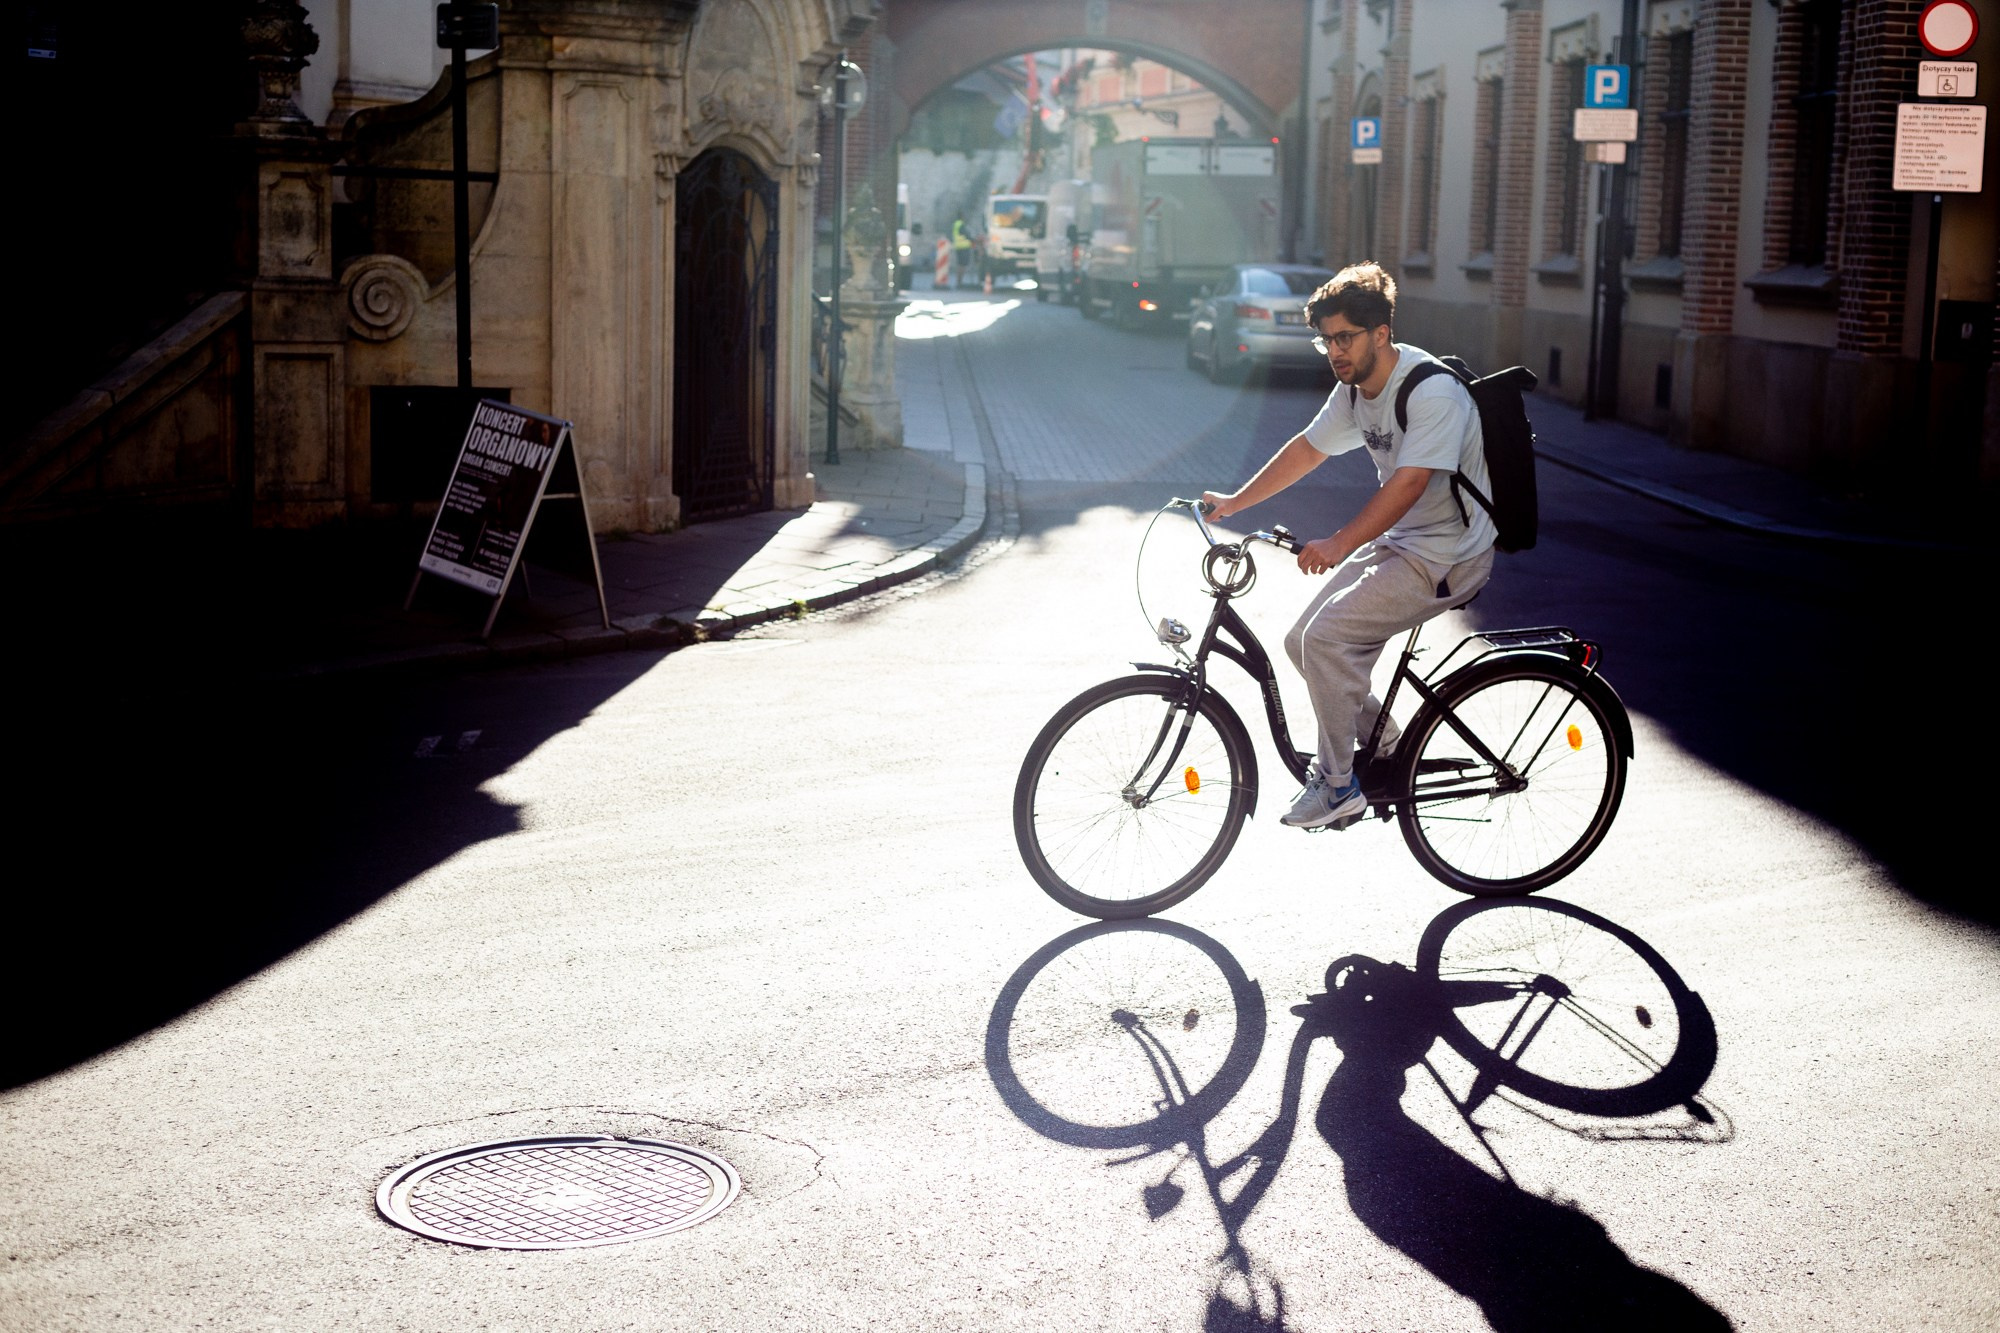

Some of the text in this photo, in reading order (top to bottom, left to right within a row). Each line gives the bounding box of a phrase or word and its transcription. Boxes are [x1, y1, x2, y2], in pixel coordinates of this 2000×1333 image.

[1922, 64, 1975, 74] Dotyczy także
[1593, 69, 1620, 105] P
[1357, 120, 1376, 145] P
[477, 405, 527, 436] KONCERT
[468, 425, 552, 472] ORGANOWY
[462, 452, 484, 468] ORGAN
[483, 458, 513, 477] CONCERT
